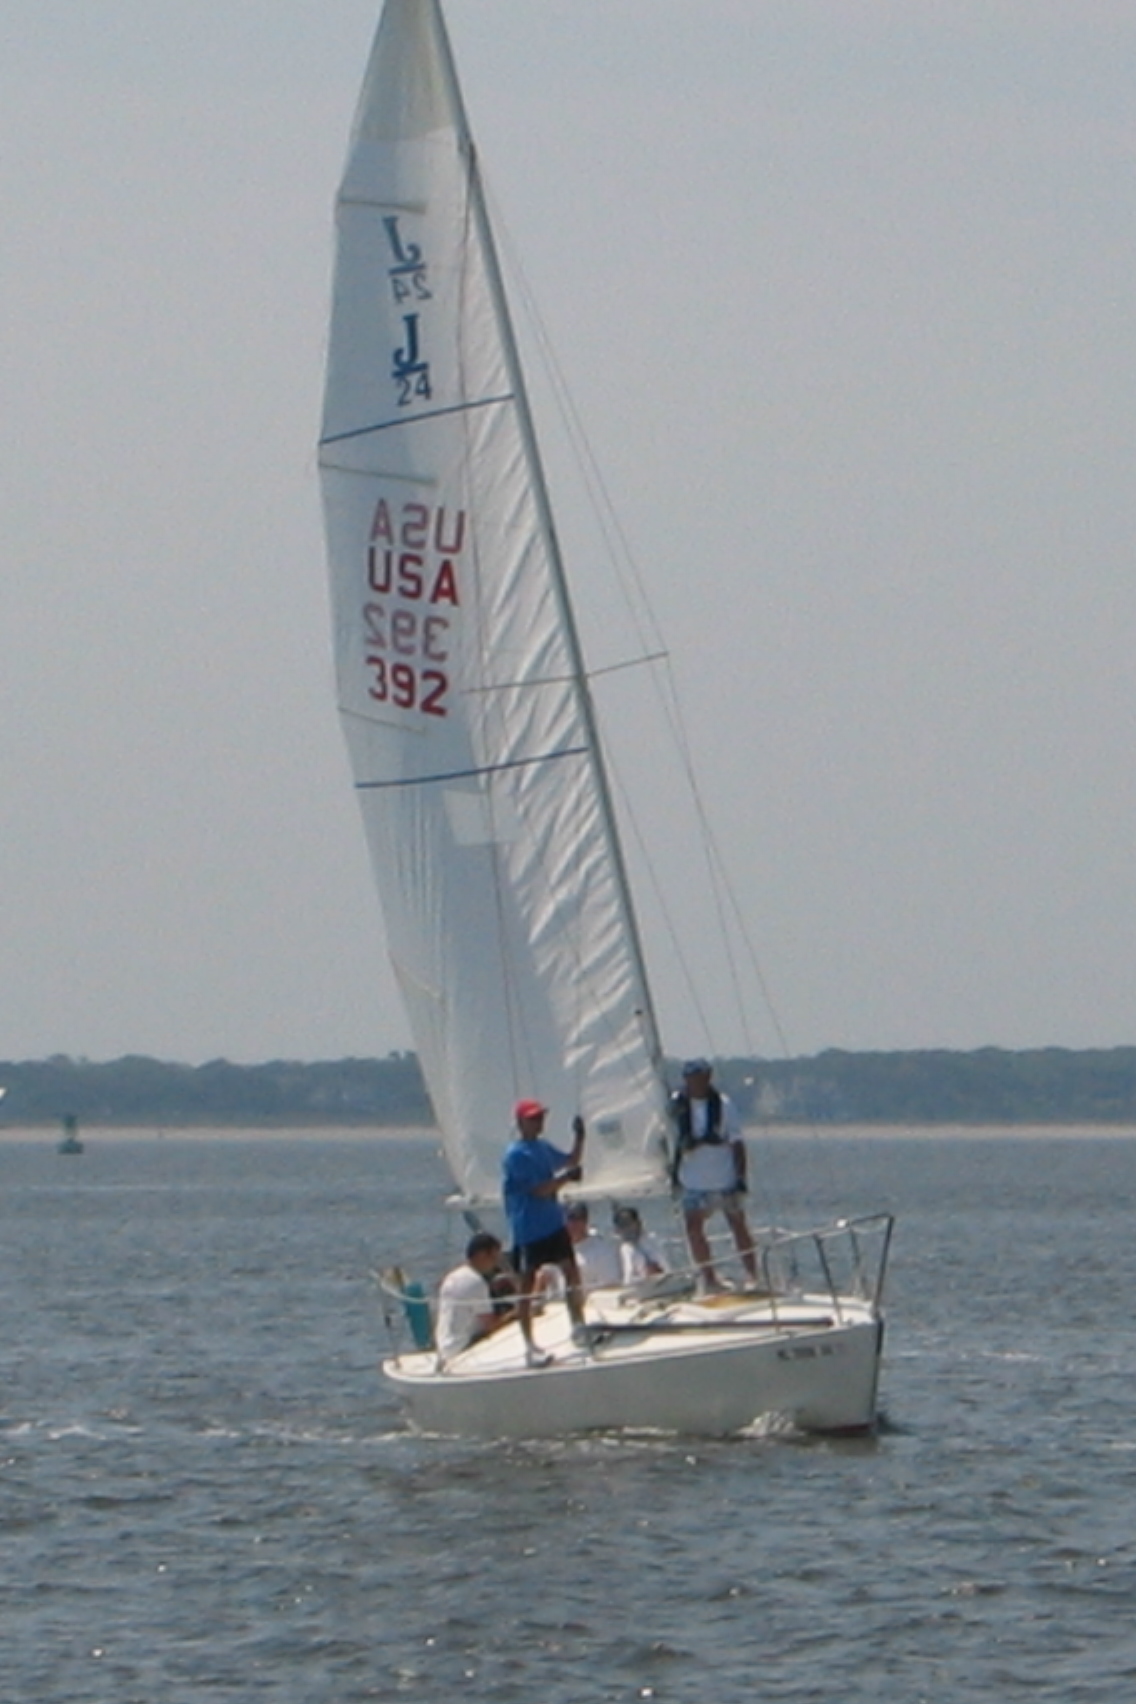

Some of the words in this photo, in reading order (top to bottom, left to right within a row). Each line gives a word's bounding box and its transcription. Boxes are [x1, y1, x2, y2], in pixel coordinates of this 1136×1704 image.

[392, 314, 421, 370] J
[396, 373, 432, 407] 24
[367, 546, 459, 606] USA
[366, 656, 449, 717] 392
